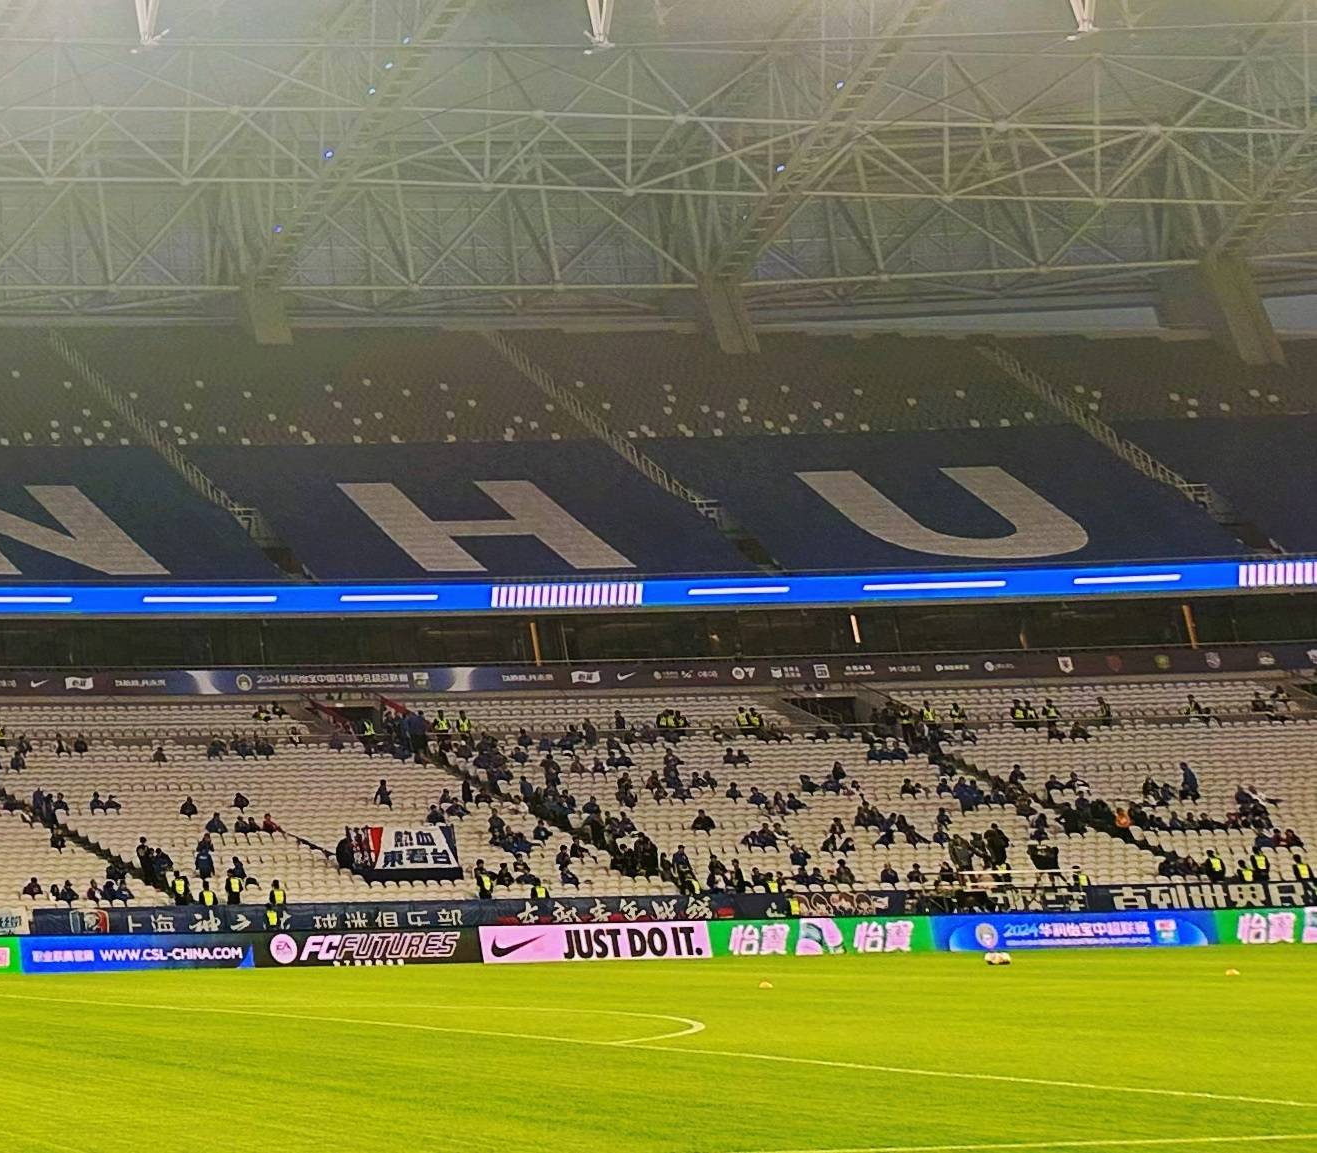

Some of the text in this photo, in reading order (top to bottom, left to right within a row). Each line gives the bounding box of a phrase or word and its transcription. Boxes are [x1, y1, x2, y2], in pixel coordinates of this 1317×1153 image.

[99, 946, 244, 962] WWW.CSL-CHINA.COM
[563, 926, 703, 960] JUST DO IT.
